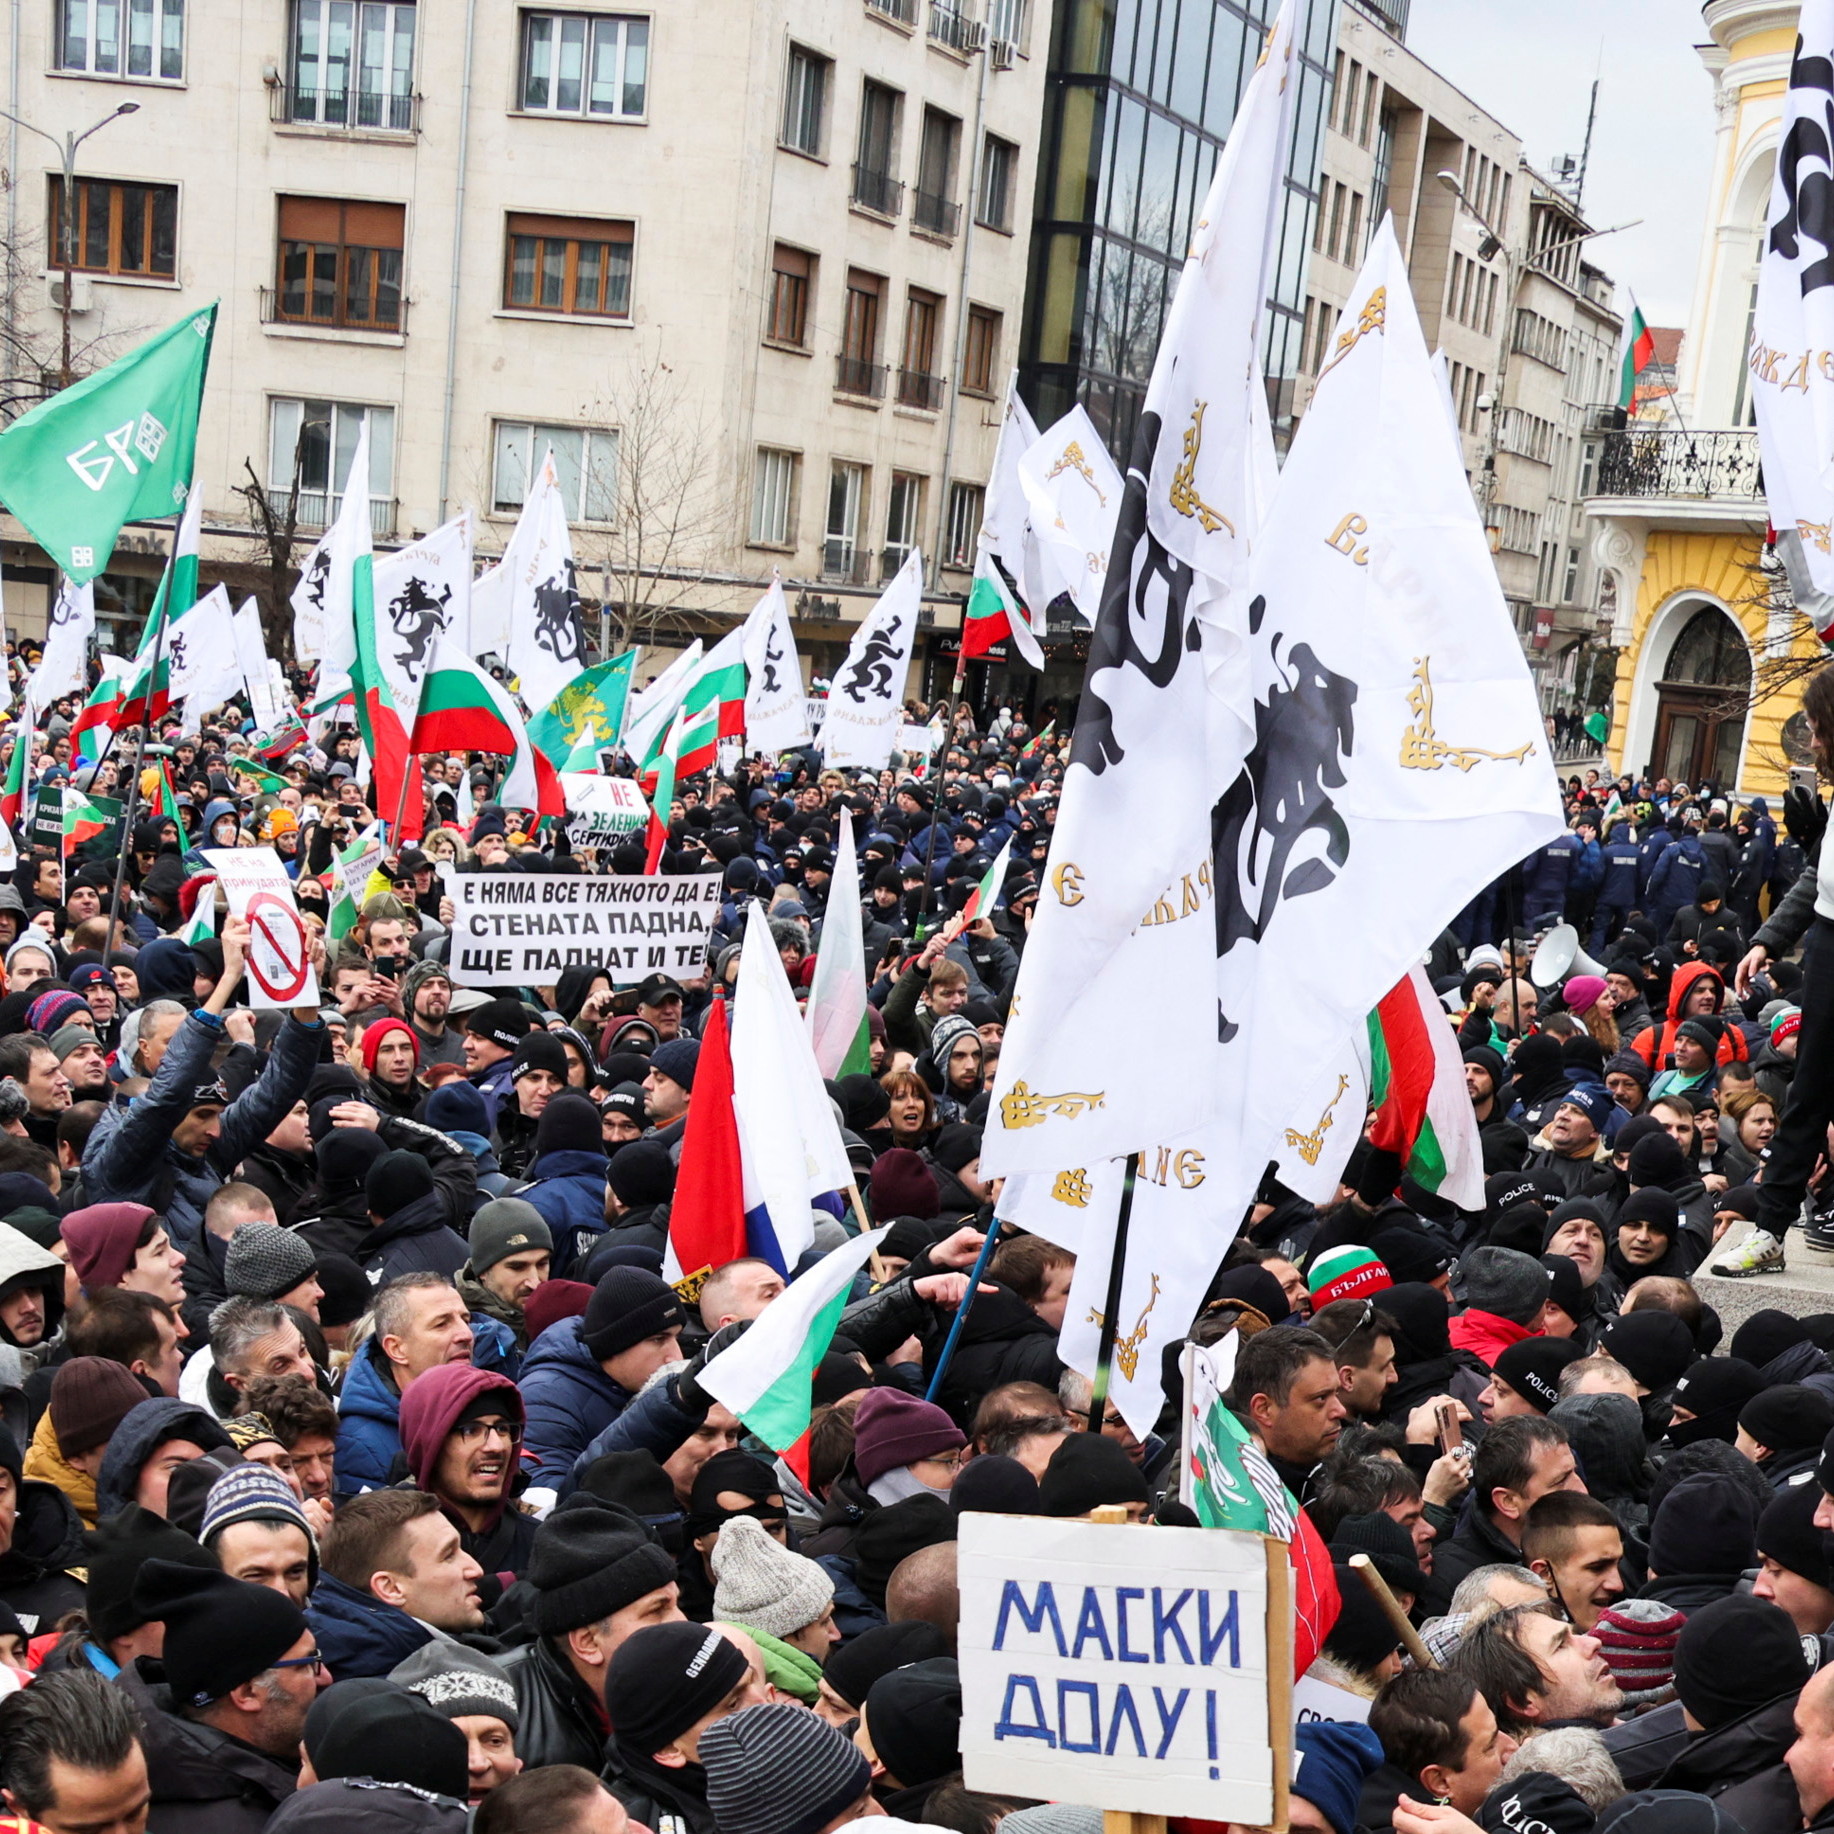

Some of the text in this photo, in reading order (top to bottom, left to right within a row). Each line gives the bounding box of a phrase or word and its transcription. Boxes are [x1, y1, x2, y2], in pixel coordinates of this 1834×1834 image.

[116, 530, 166, 555] ank
[608, 782, 634, 807] НЕ
[464, 881, 721, 906] Е НЯМА ВСЕ ТЯХНОТО ДА Е!
[470, 911, 711, 938] СТЕНАТА ПАДНА,
[460, 944, 709, 976] ЩЕ ПАДНАТ И ТЕ!
[493, 1029, 520, 1045] ПОЛИЦ
[1498, 1182, 1535, 1207] POLICE
[1524, 1371, 1559, 1404] POLICE
[992, 1579, 1242, 1669] МАСКИ
[994, 1673, 1221, 1782] ДОЛУ!
